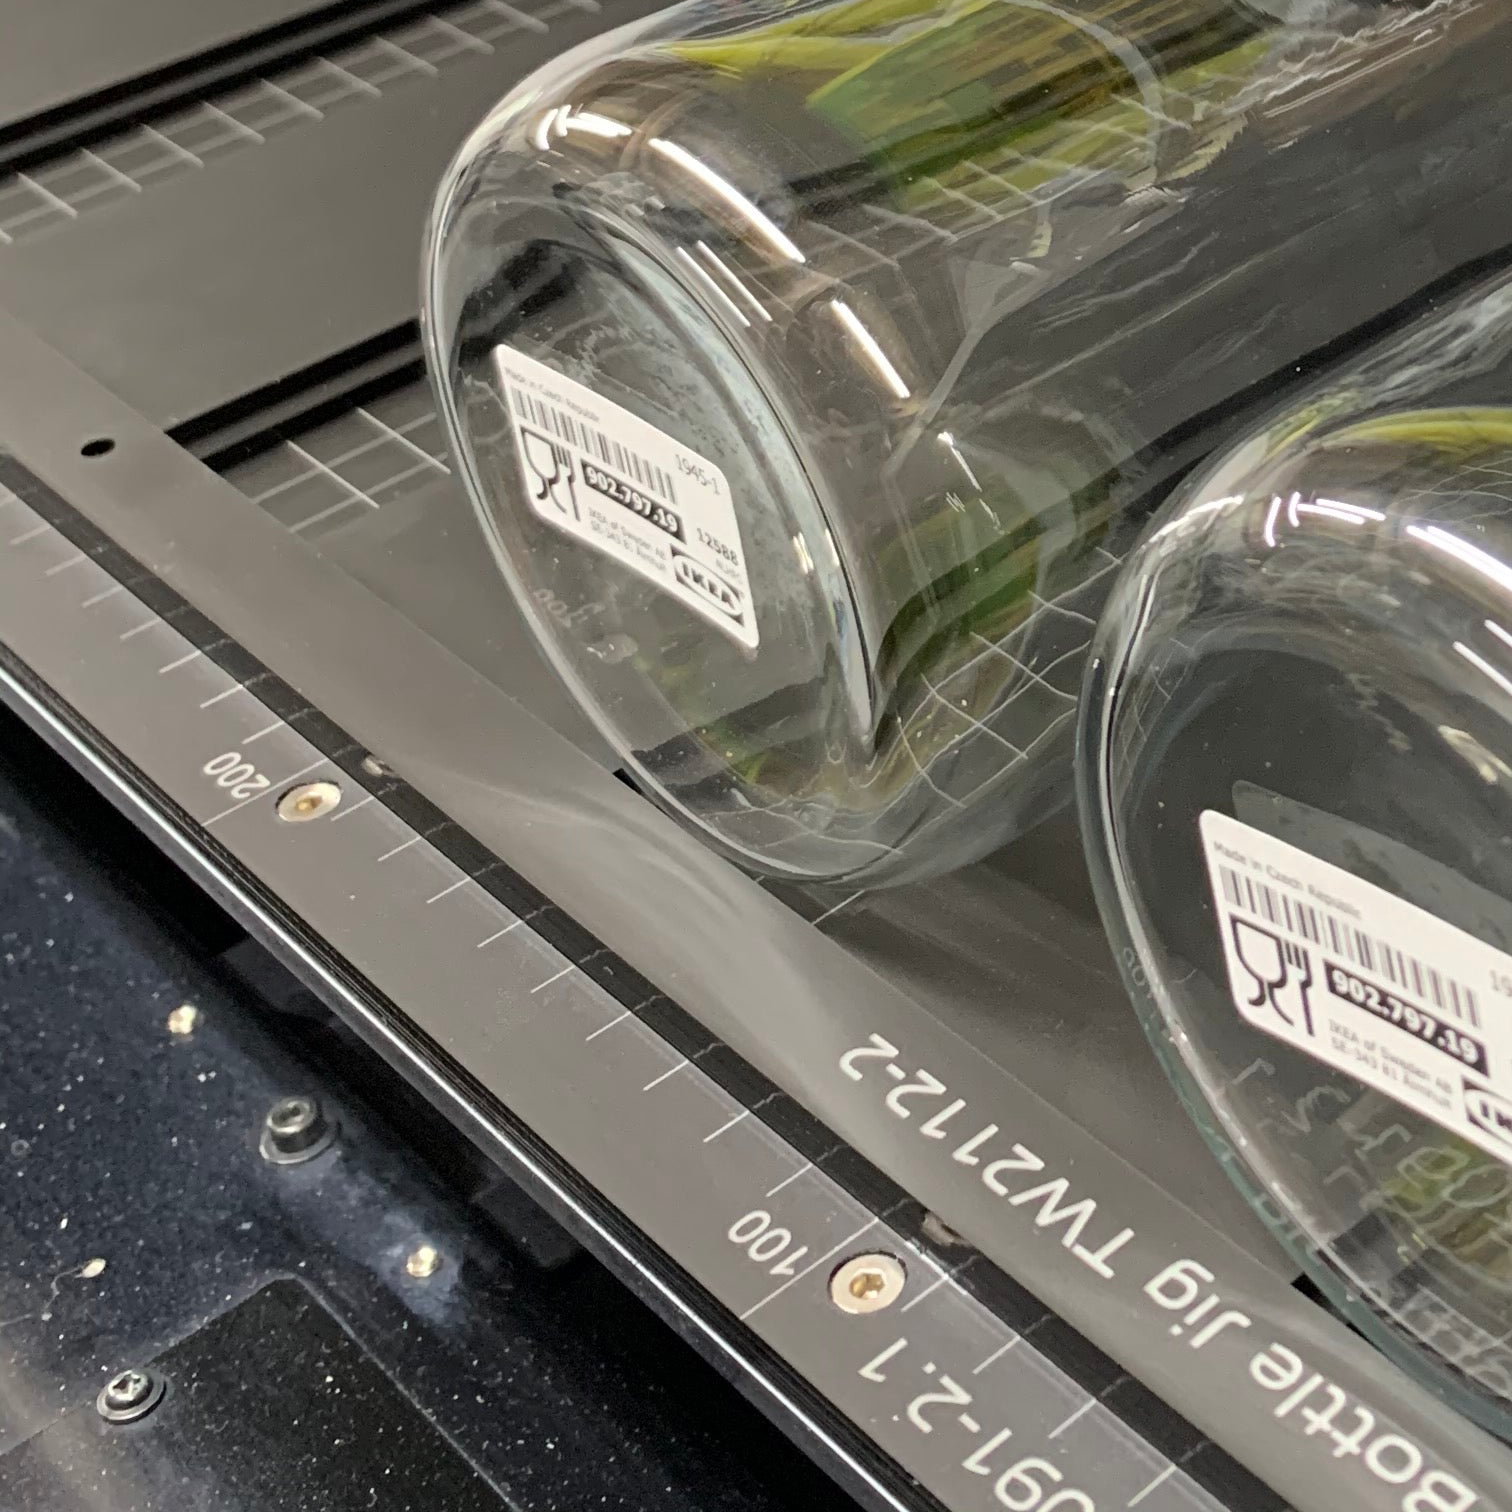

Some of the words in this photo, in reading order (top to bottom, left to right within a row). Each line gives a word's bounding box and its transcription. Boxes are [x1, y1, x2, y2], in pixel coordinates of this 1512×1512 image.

[585, 464, 679, 535] 902.797.19
[674, 452, 720, 496] 1945-1
[695, 525, 739, 567] 12588
[680, 560, 736, 611] IKEA
[202, 750, 271, 801] 200
[1330, 964, 1480, 1068] 902.797.19
[838, 1033, 1136, 1280] TW2112-2
[728, 1208, 802, 1279] 100
[1143, 1259, 1252, 1350] Jig
[1248, 1342, 1478, 1512] Bottle
